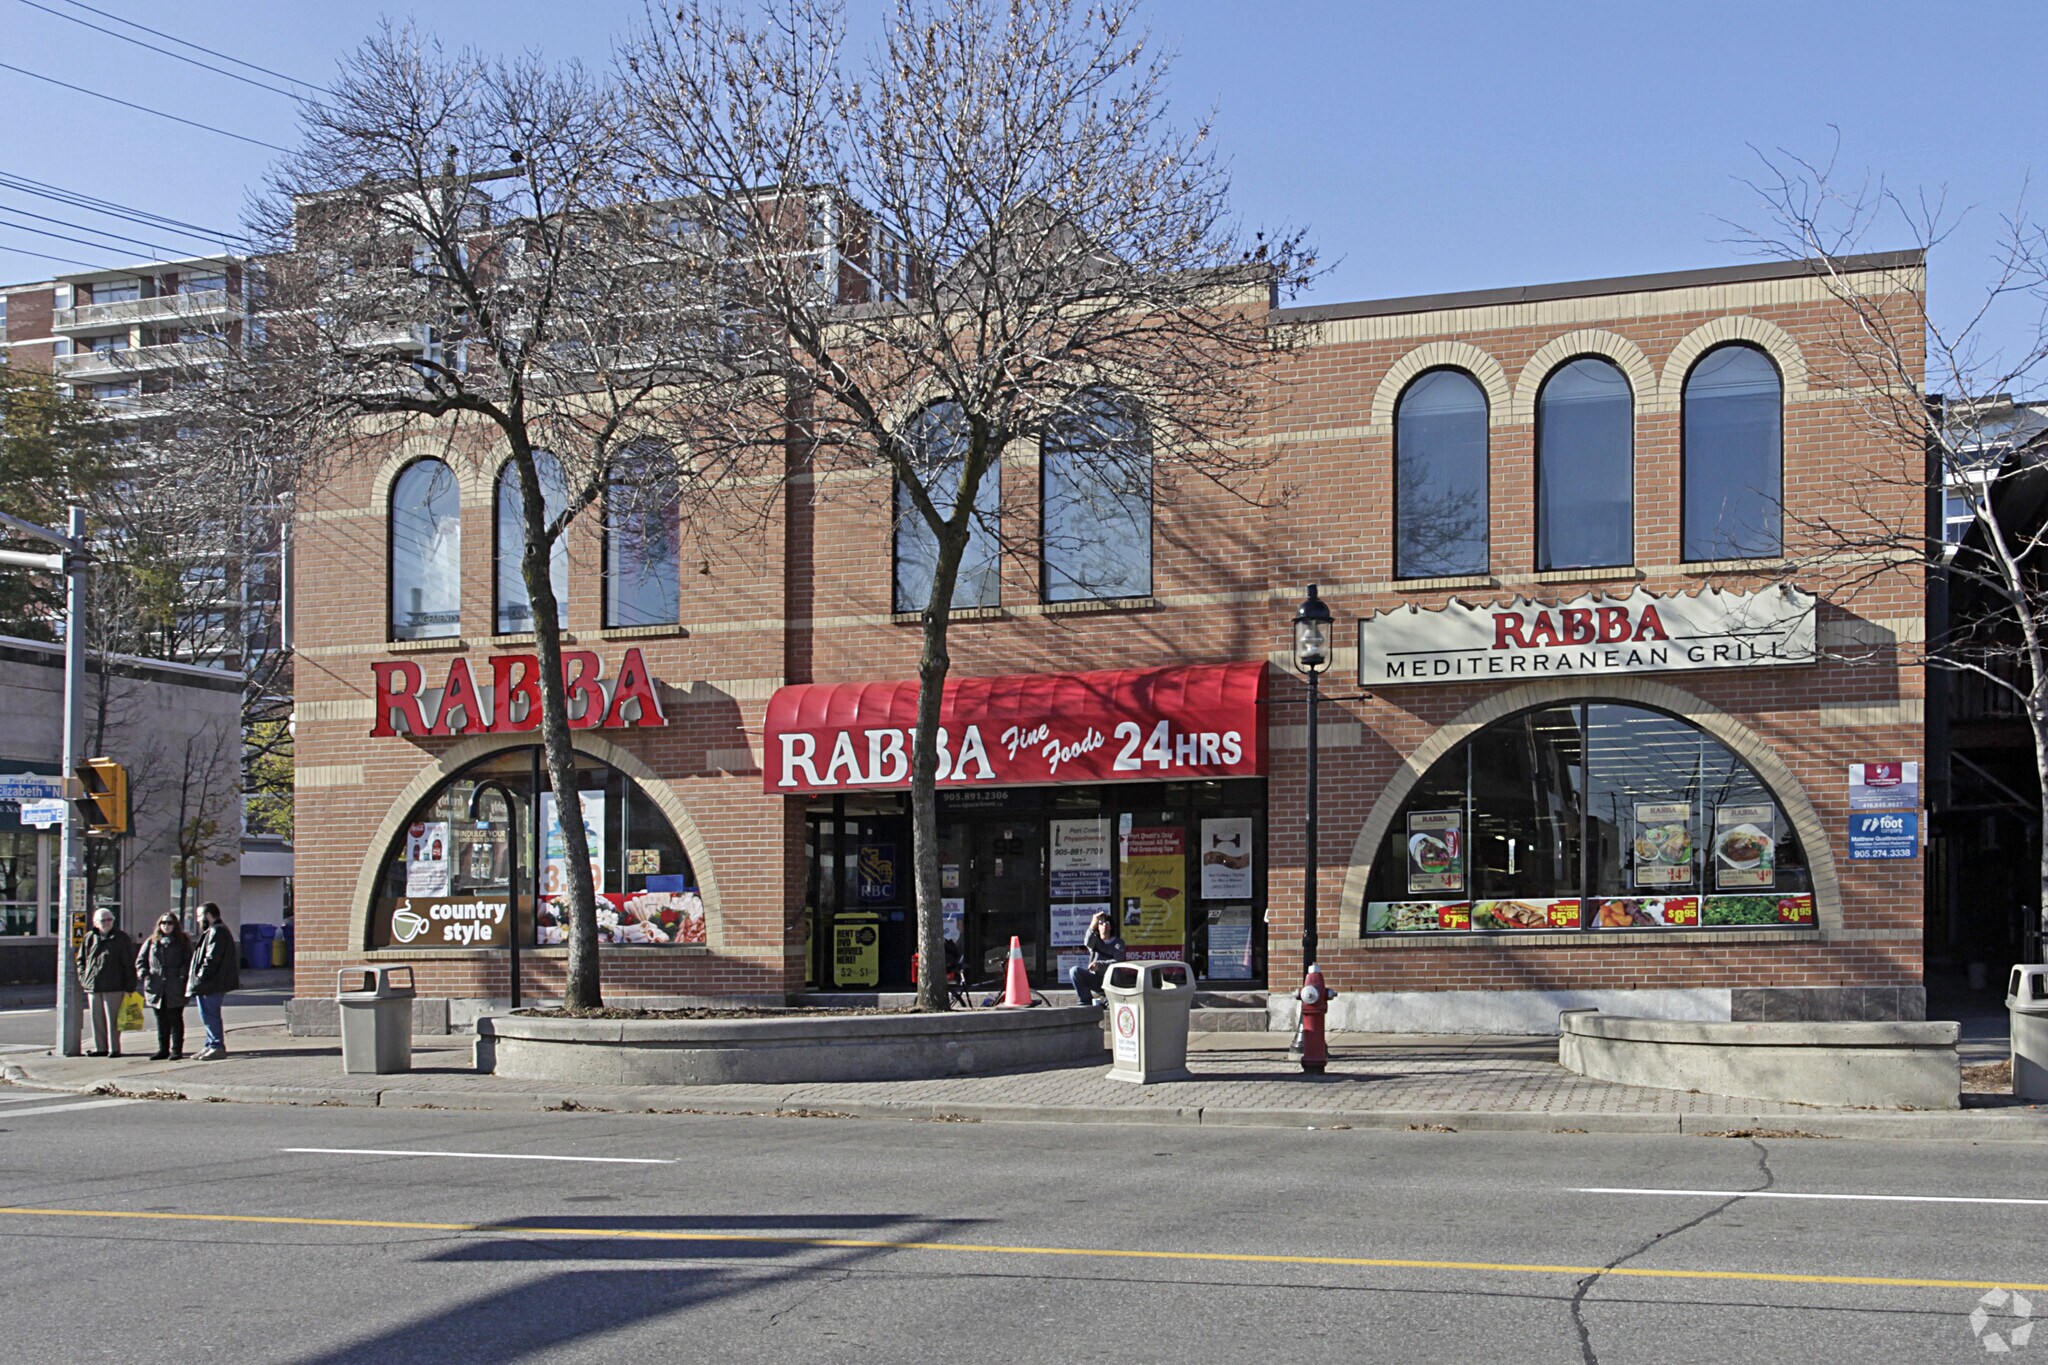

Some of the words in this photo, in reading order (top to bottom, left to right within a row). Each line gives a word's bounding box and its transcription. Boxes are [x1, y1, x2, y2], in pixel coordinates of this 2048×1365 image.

[1492, 604, 1669, 650] RABBA
[1386, 647, 1669, 678] MEDITERRANEAN
[1687, 640, 1788, 663] GRILL
[370, 648, 668, 737] RABBA
[1001, 723, 1049, 761] Fine
[1042, 726, 1105, 774] Foods
[53, 786, 61, 798] N
[943, 791, 1009, 801] 905.891.2306
[1880, 818, 1903, 829] foot
[1054, 847, 1104, 856] 905-891-7709
[1854, 848, 1911, 858] 905.274.3338
[861, 885, 891, 897] RBC
[429, 900, 507, 924] country
[443, 919, 493, 945] style
[836, 929, 854, 939] RENT
[1125, 950, 1181, 960] 905-278-WOOF
